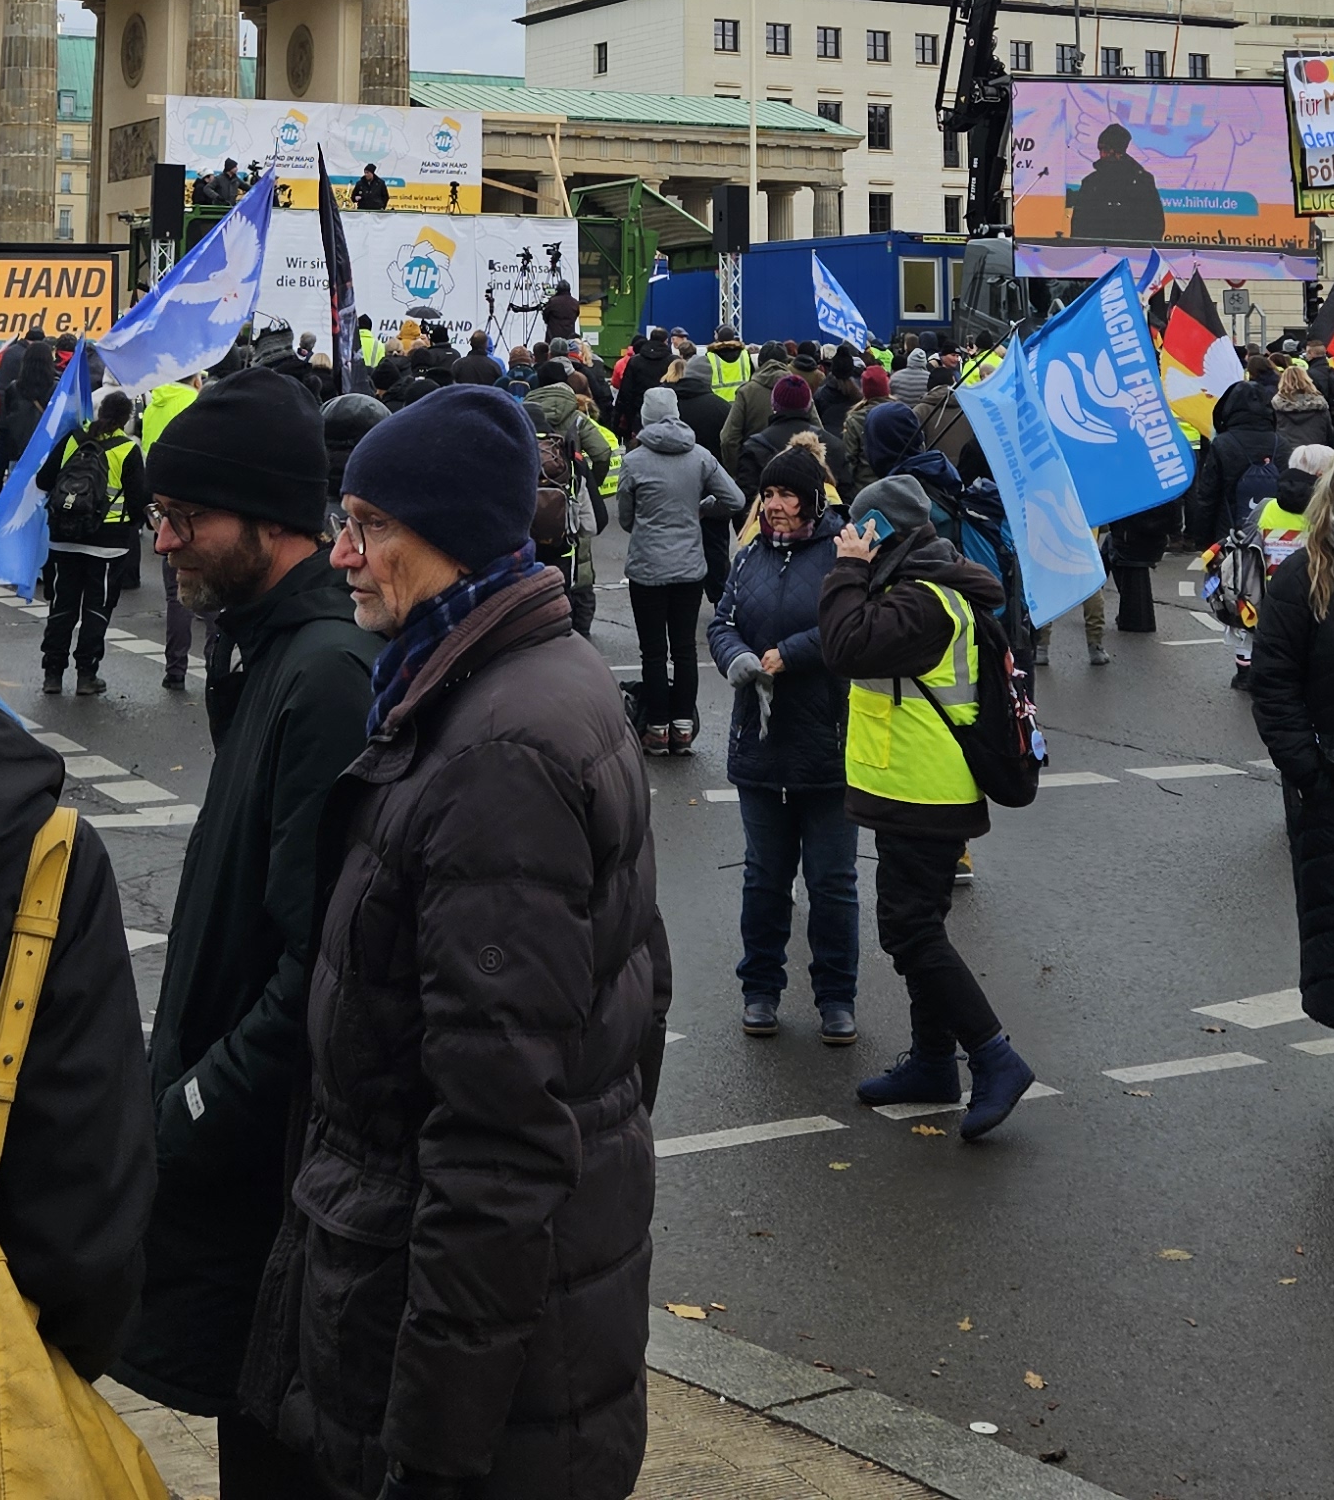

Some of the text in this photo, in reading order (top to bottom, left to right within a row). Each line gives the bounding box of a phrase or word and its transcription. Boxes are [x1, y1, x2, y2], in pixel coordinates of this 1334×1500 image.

[1298, 90, 1321, 117] für
[1013, 138, 1035, 152] ND
[1162, 195, 1238, 210] ww.hihful.de
[1245, 233, 1277, 248] sind
[286, 256, 307, 269] Wir
[4, 267, 106, 298] HAND
[276, 276, 297, 288] die
[403, 264, 440, 290] HiH
[55, 306, 103, 332] e.V.
[819, 304, 865, 343] PEACE
[1099, 275, 1188, 490] MACHT FRIEDEN!
